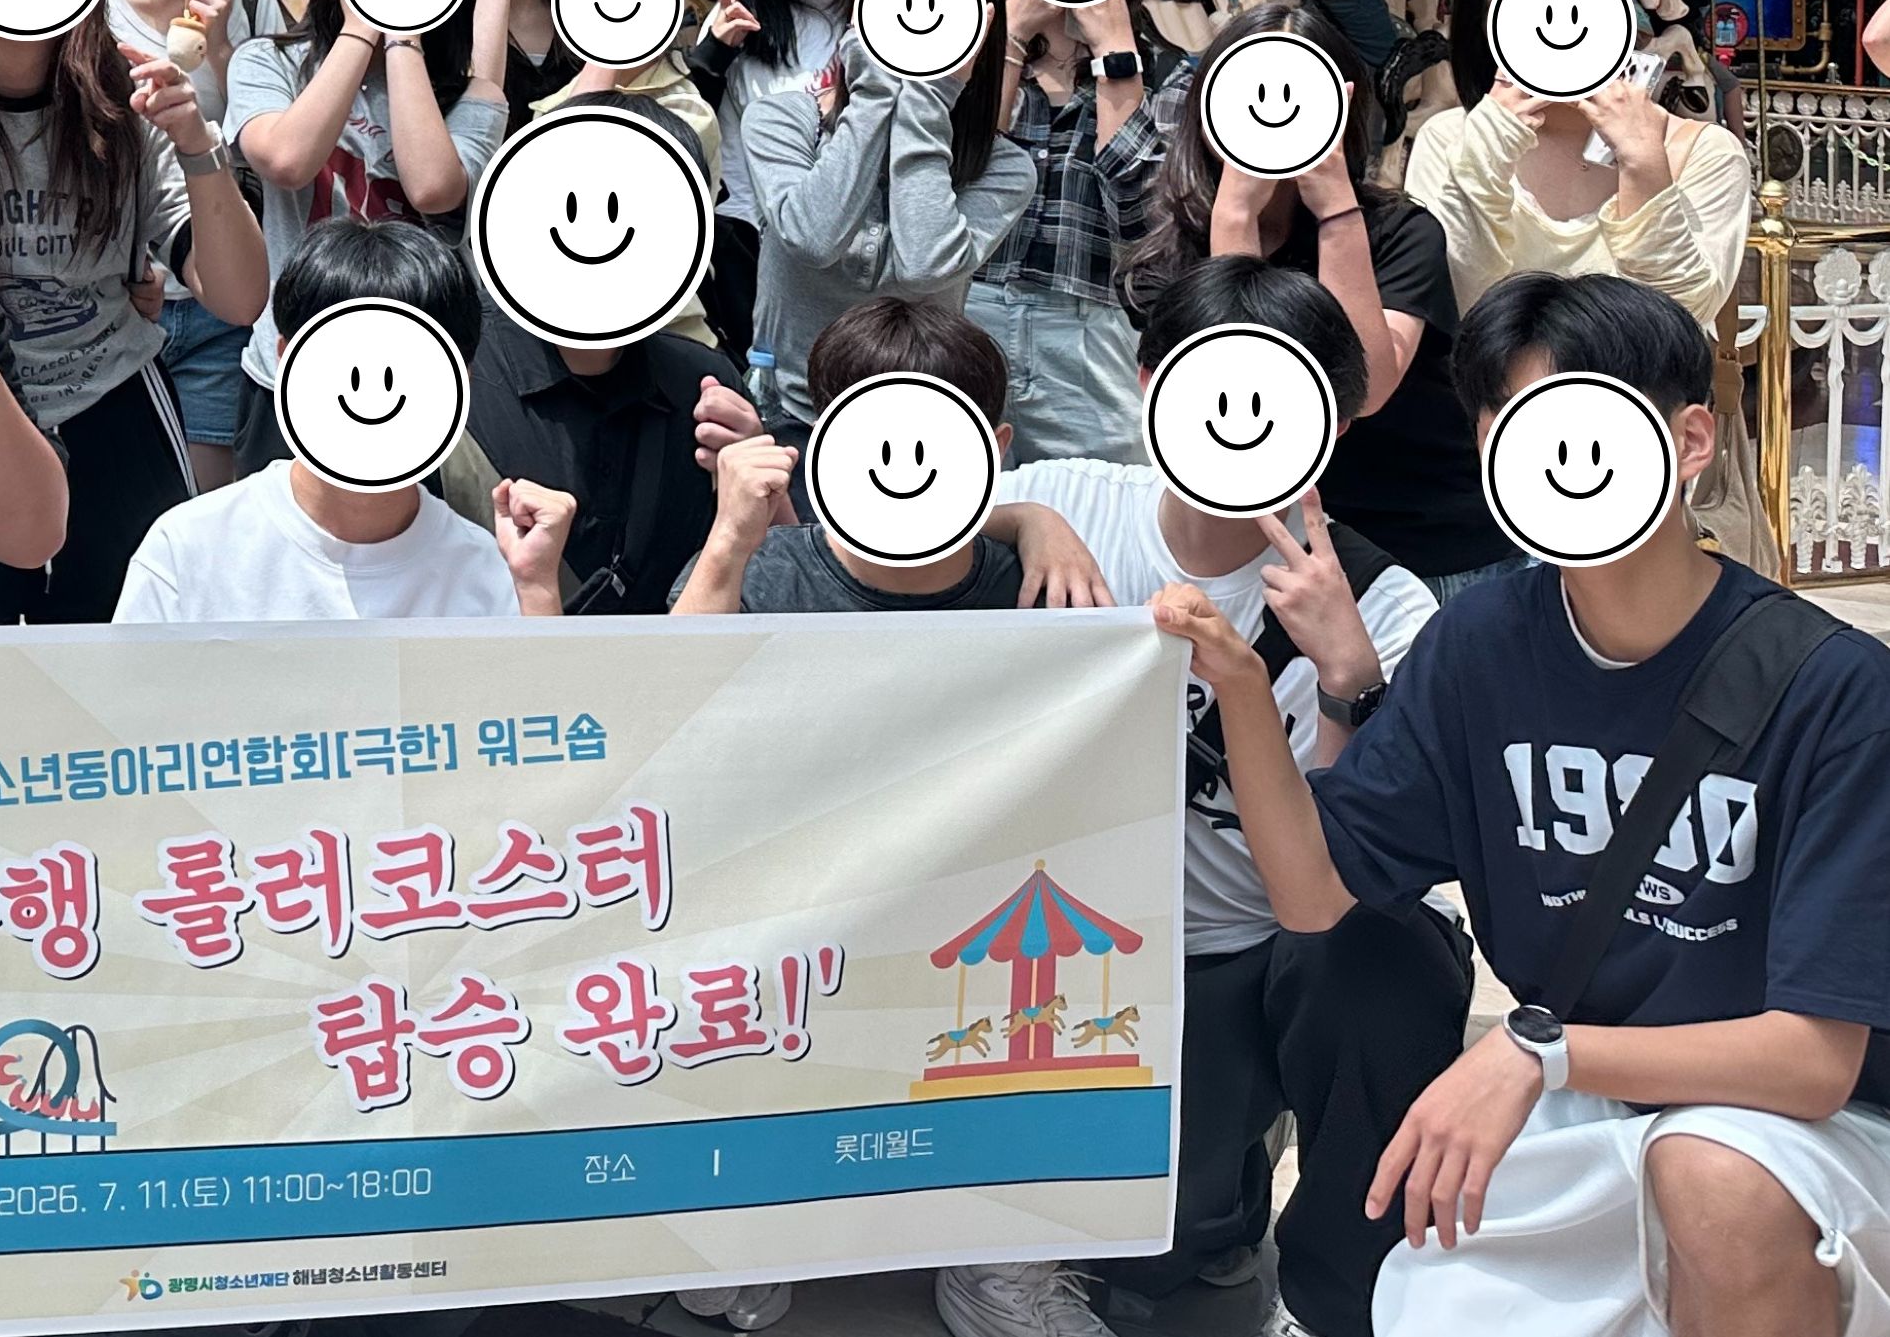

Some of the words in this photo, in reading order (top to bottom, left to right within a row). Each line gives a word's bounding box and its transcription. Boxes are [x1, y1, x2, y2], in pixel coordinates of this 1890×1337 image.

[477, 712, 608, 767] 워크숍
[139, 802, 665, 962] 롤러코스터
[1540, 888, 1587, 907] NOTH
[314, 973, 525, 1105] 탑승
[584, 1153, 637, 1185] 장소
[833, 1127, 935, 1164] 롯데월드
[98, 1182, 126, 1212] 7.
[243, 1166, 432, 1205] 11:00~18:00
[168, 1271, 289, 1293] 광명시청소년재단
[292, 1260, 447, 1286] 해냄청소년활동센터
